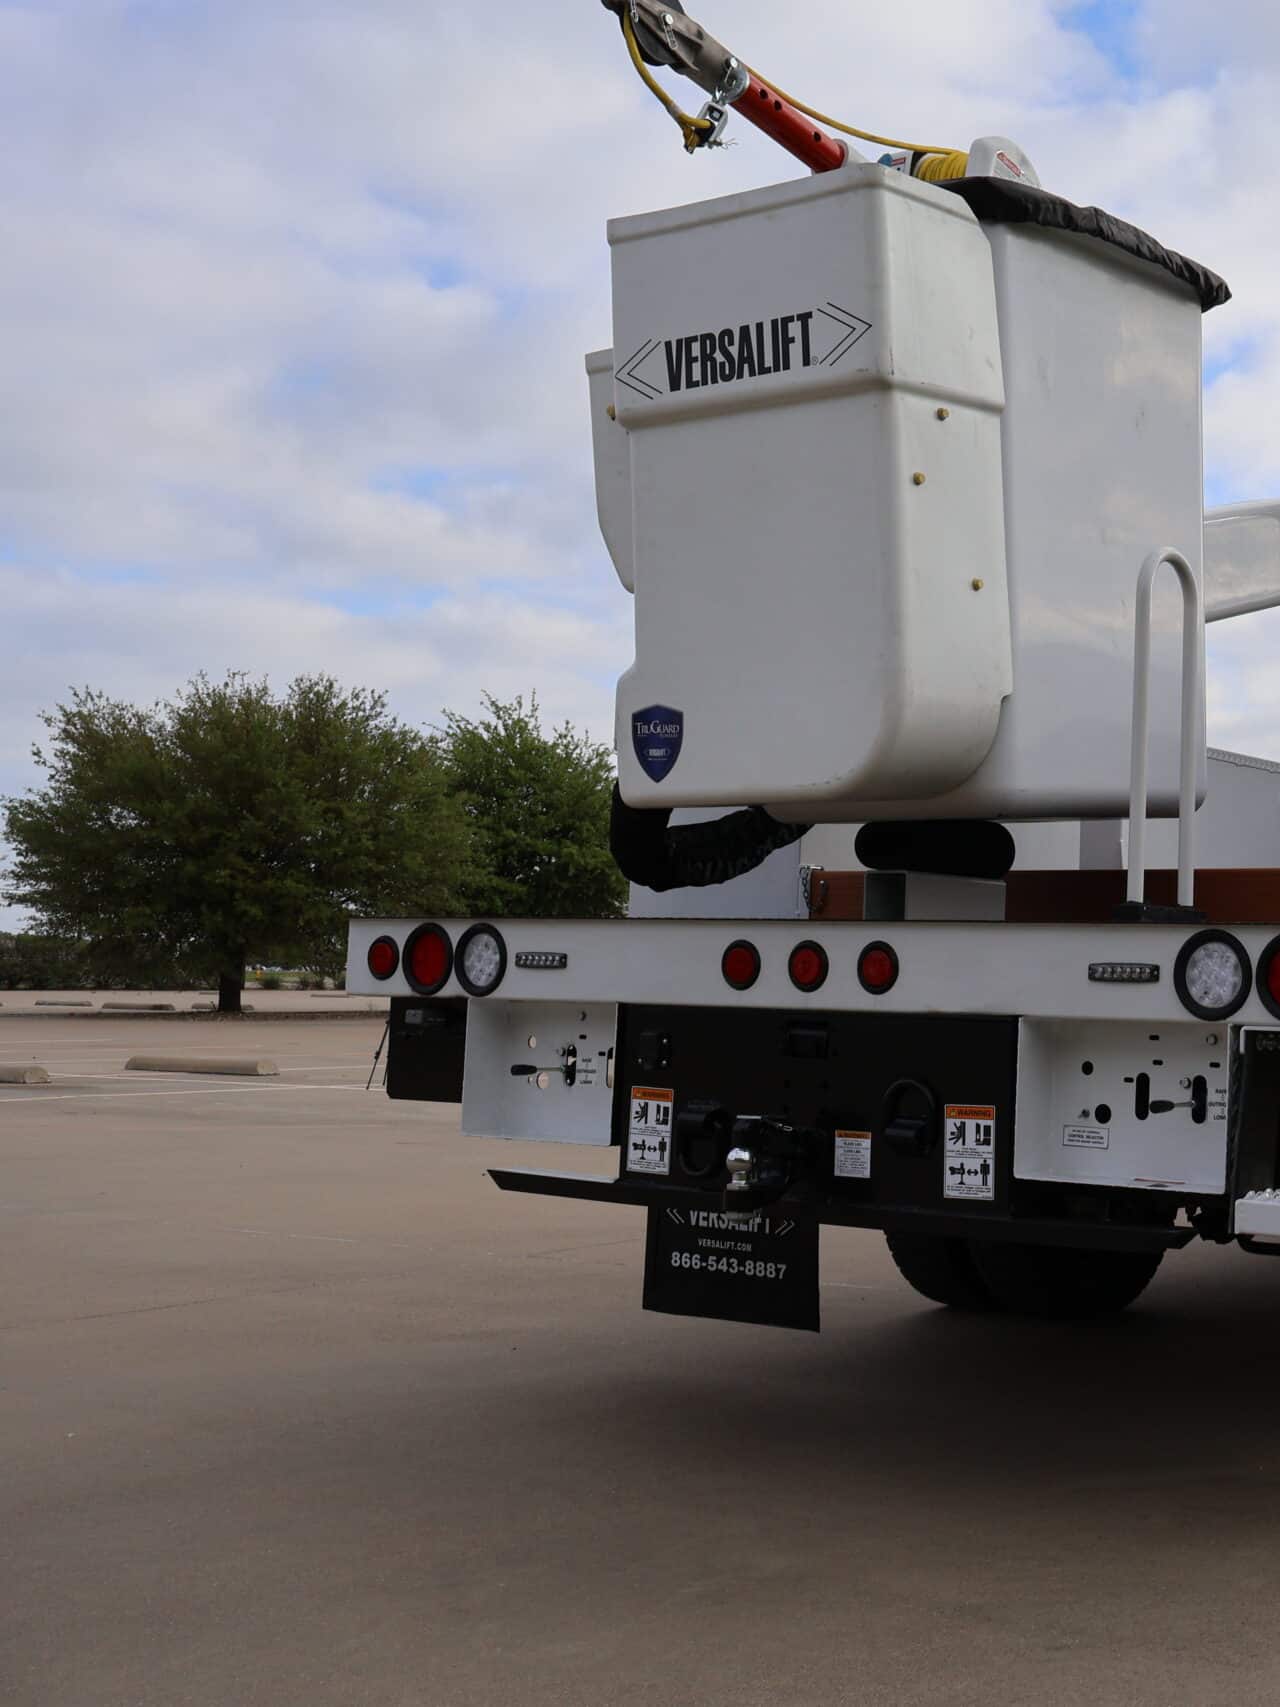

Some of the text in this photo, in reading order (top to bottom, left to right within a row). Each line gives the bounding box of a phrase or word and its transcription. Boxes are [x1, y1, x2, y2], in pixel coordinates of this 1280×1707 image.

[664, 311, 813, 392] VERSALIFT
[698, 1238, 753, 1252] VERSALIFT.COM
[671, 1251, 787, 1280] 866-543-8887
